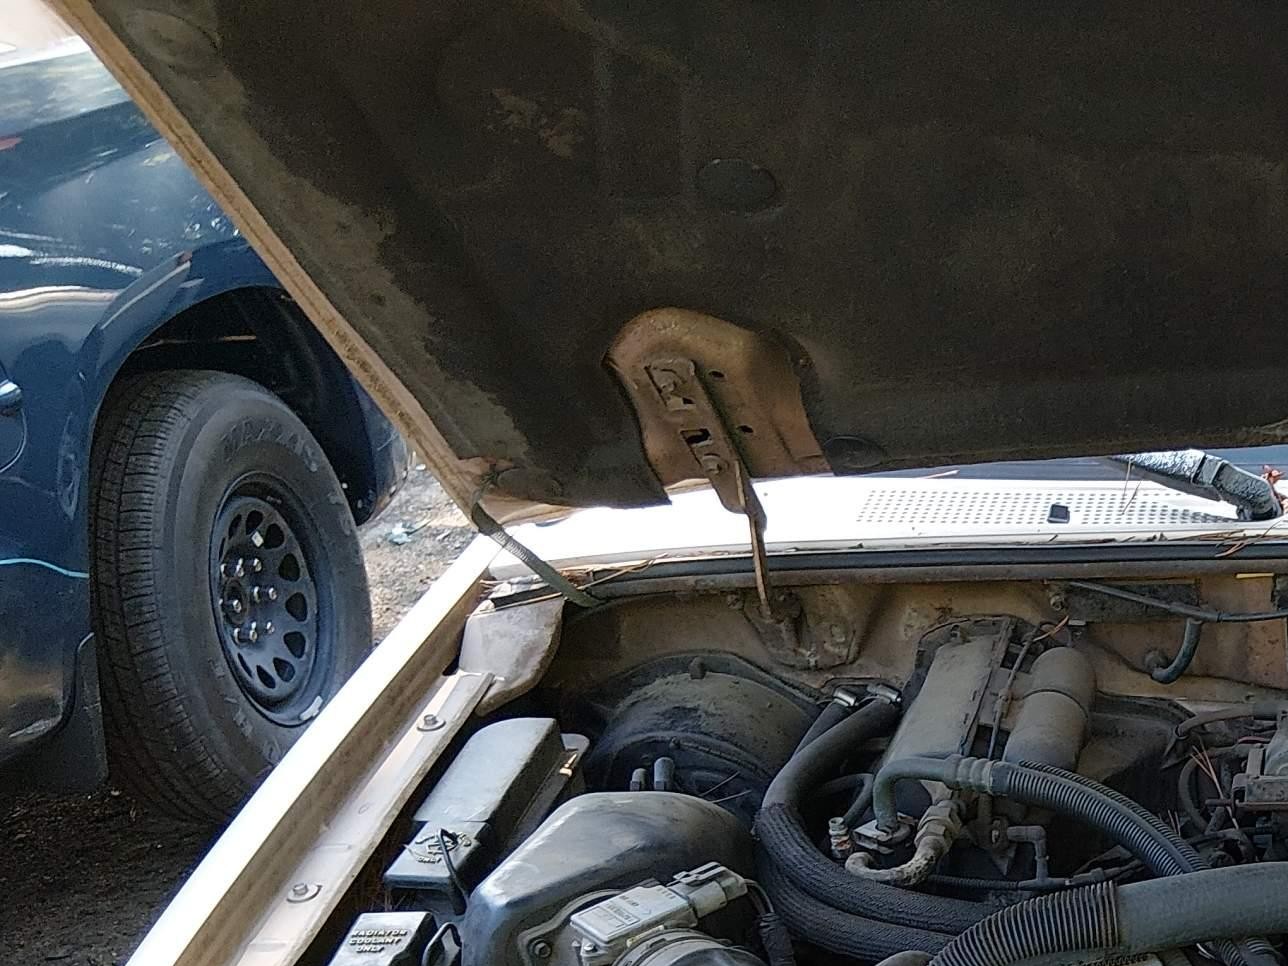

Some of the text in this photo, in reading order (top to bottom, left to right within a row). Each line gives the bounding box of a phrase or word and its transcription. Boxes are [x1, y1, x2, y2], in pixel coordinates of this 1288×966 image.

[351, 929, 408, 938] RADIATOR
[349, 937, 402, 946] COOLANT
[356, 946, 385, 954] ONLY
